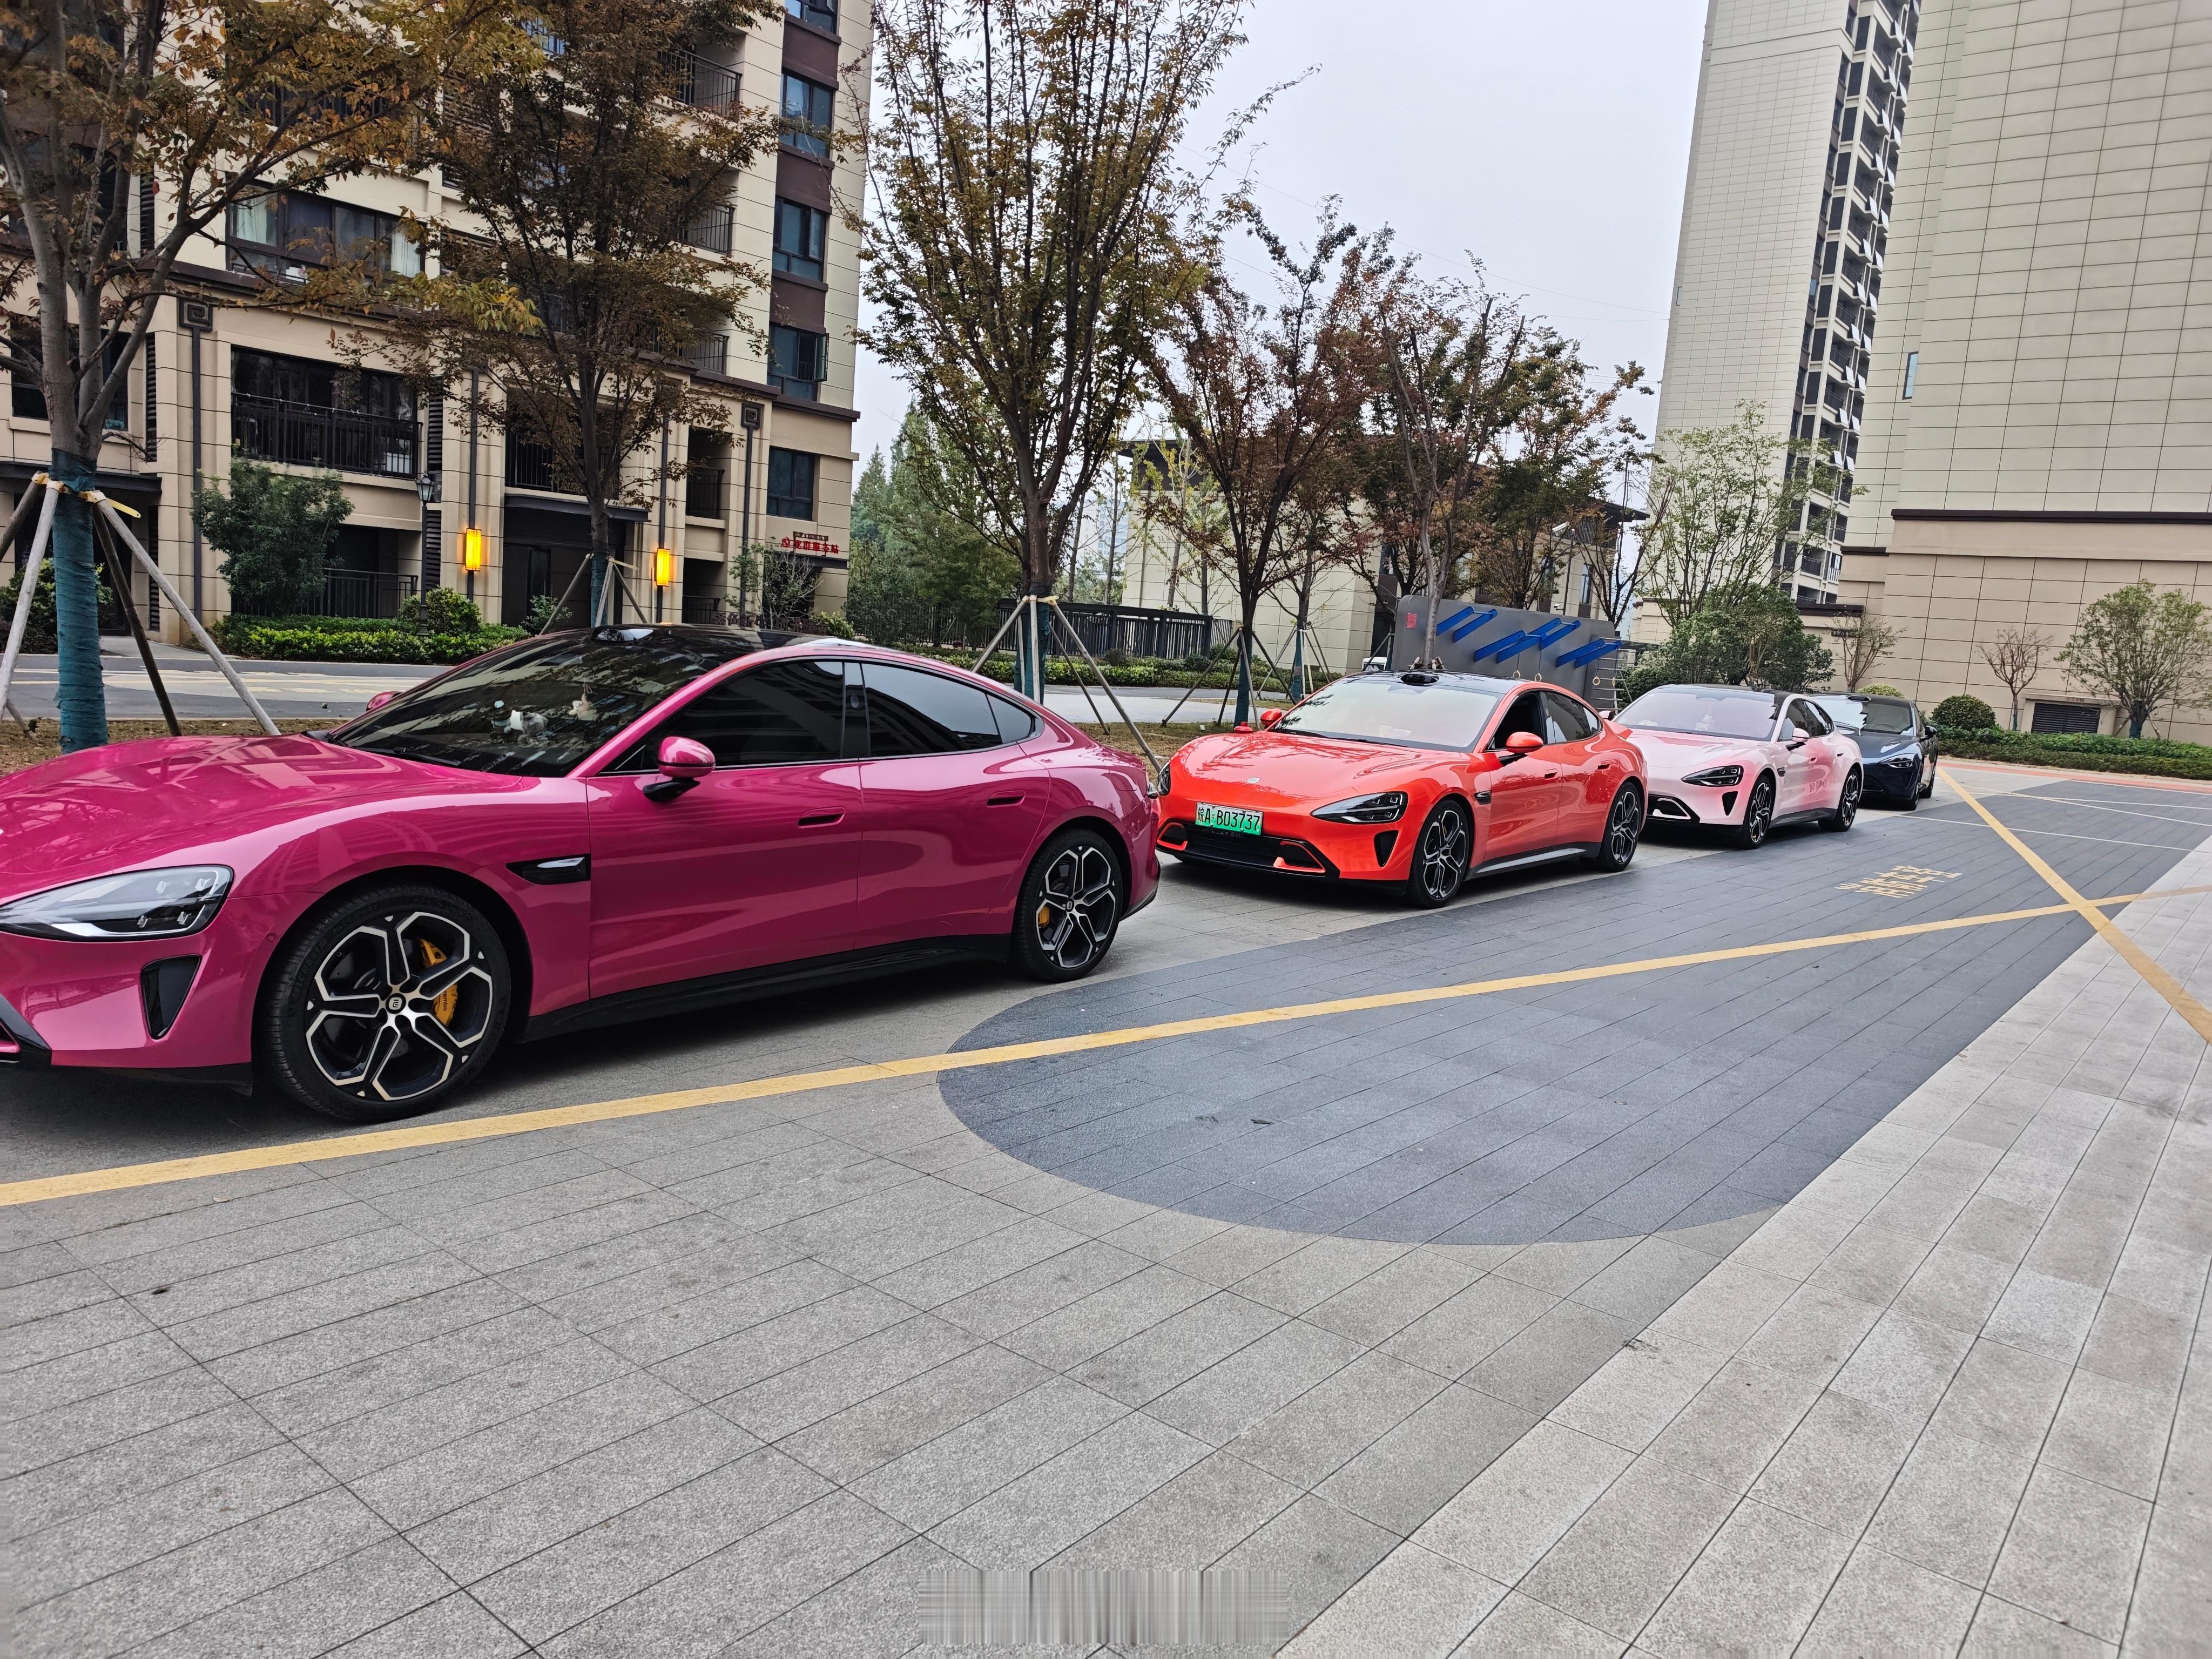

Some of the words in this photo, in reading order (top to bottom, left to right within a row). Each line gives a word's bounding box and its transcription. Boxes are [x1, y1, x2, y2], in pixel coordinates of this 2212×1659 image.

[1197, 807, 1211, 824] 皖A
[1216, 810, 1260, 831] B03737
[1835, 865, 1964, 898] 消防车登
